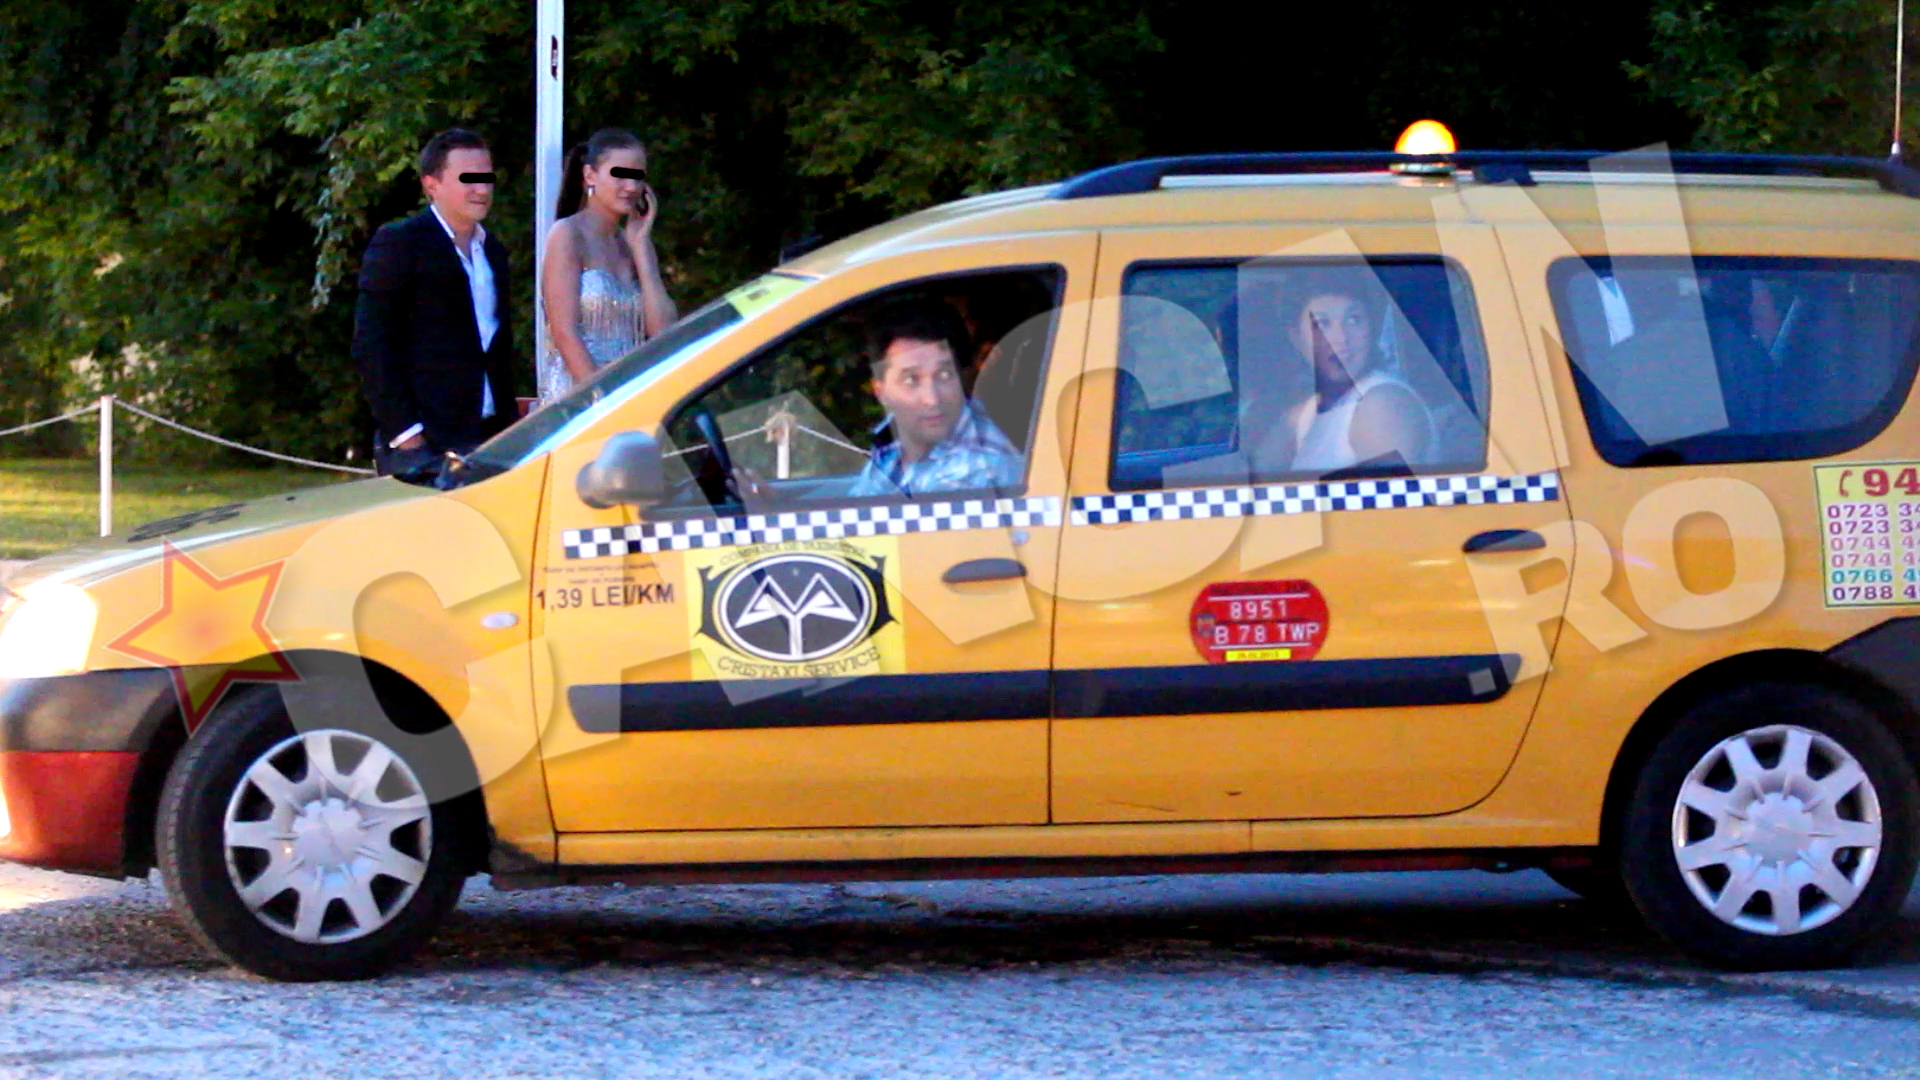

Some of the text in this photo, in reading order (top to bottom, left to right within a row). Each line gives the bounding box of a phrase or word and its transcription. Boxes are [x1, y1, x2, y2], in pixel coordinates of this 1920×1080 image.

[1827, 504, 1888, 518] 0723
[1829, 520, 1890, 535] 0723
[1831, 537, 1891, 551] 0744
[1831, 553, 1892, 568] 0744
[1832, 570, 1893, 584] 0766
[536, 583, 675, 612] 1,39 LEI/KM
[1833, 586, 1894, 601] 0788
[1229, 599, 1288, 621] 8951
[1214, 622, 1321, 645] B 78 TWP
